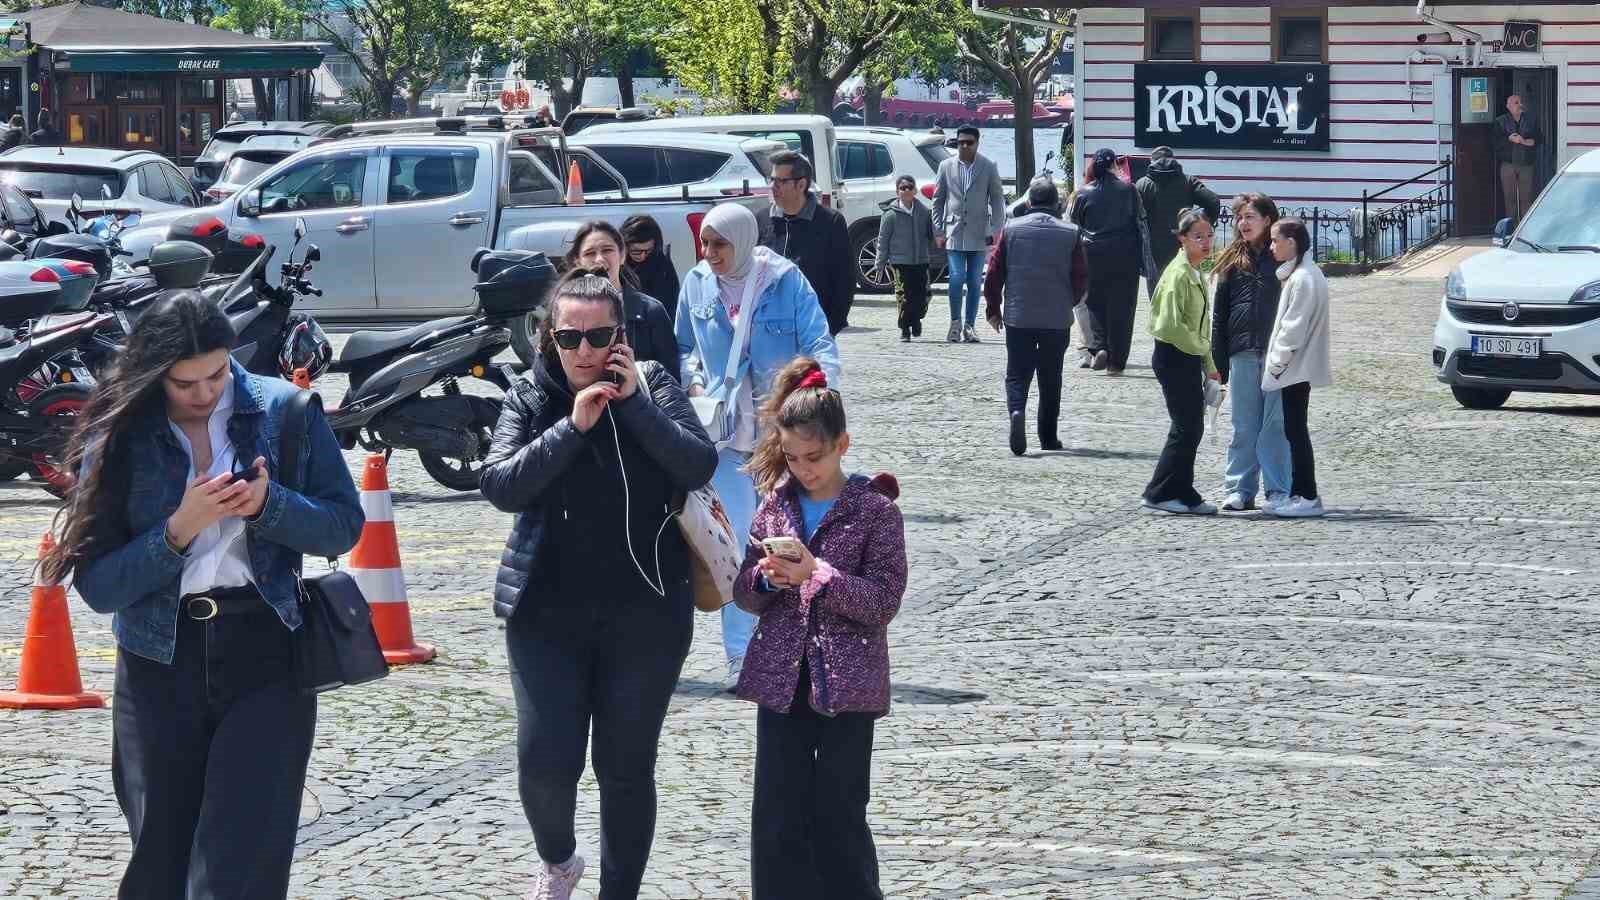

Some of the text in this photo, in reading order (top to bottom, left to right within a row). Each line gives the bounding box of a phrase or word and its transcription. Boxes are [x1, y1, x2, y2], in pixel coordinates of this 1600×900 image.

[1504, 25, 1537, 48] WC
[203, 60, 220, 69] CAFE
[1480, 339, 1537, 354] 10 SD 491
